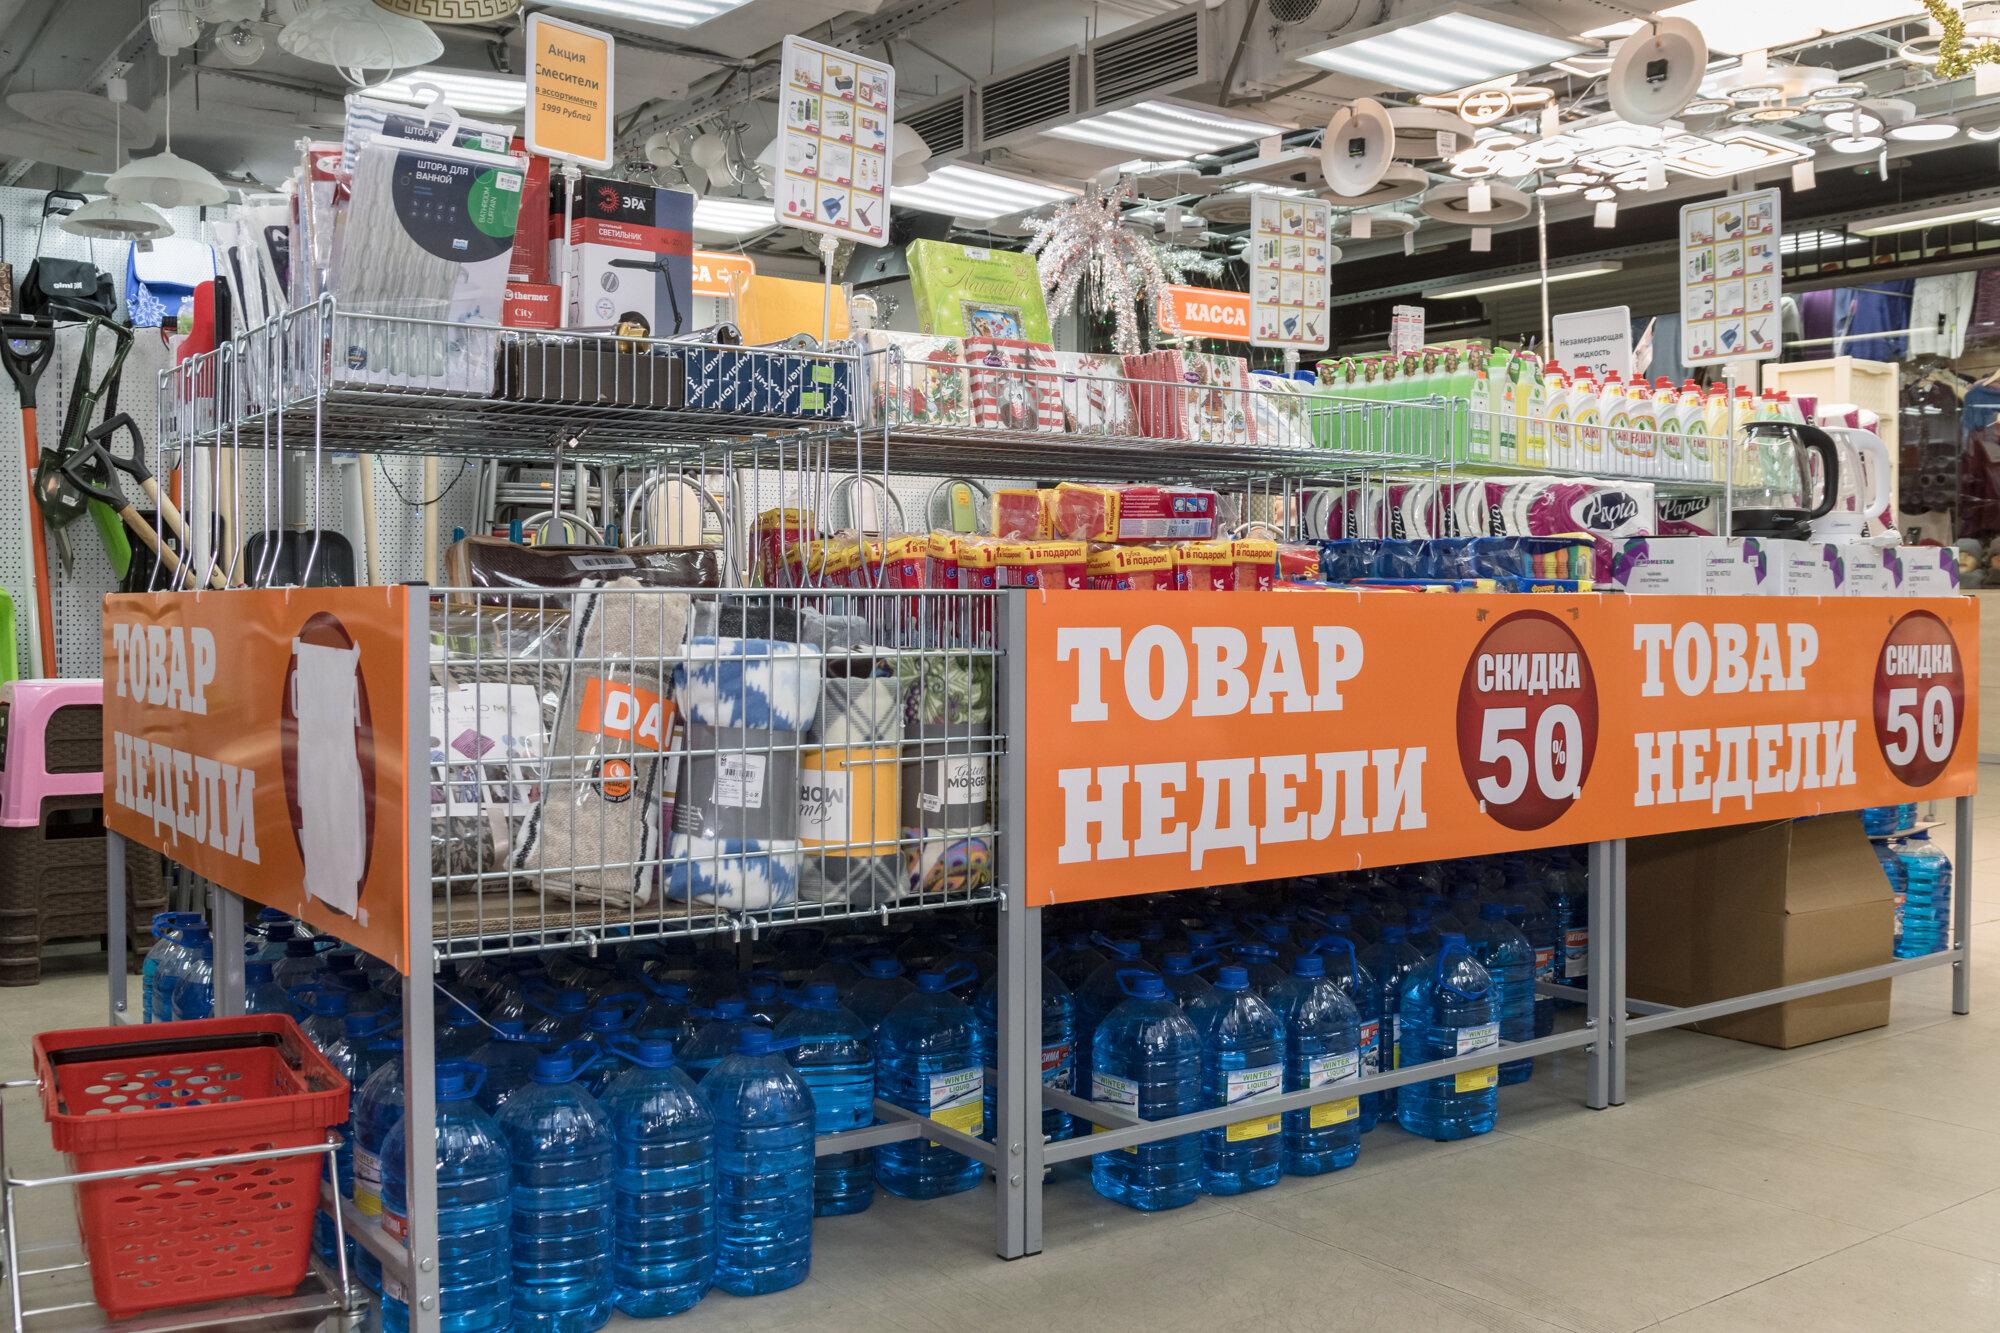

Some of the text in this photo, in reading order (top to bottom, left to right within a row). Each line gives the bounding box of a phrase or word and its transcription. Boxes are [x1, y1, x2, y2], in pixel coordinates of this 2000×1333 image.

[548, 43, 586, 64] Акция
[535, 63, 599, 90] Смесители
[541, 87, 598, 108] ассортименте
[541, 102, 592, 121] 1999 Рублей
[404, 125, 435, 138] ШТОРА
[417, 159, 469, 176] ШТОРА ДЛЯ
[415, 171, 453, 185] ВАННОЙ
[478, 186, 491, 224] BATHROOM
[486, 196, 497, 225] CURTAIN
[622, 196, 646, 211] ЭРА
[598, 228, 642, 241] СВЕТИЛЬНИК
[514, 290, 549, 302] thermex
[514, 307, 534, 318] City
[1185, 302, 1247, 327] КАССА
[1559, 332, 1625, 347] Незамерзающая
[1573, 349, 1612, 360] жидкость
[1631, 432, 1653, 445] FAIRY
[1587, 490, 1638, 532] Papia
[1662, 496, 1711, 521] Papia
[1036, 550, 1042, 558] в
[1043, 547, 1082, 560] подарок!
[1126, 553, 1168, 566] в подарок!
[1192, 549, 1227, 561] подарок!
[1241, 549, 1273, 560] подарок!
[1633, 622, 1820, 698] ТОВАР
[1885, 643, 1954, 680] СКИДКА
[113, 622, 217, 715] ТОВАР
[1056, 624, 1365, 723] ТОВАР
[1476, 651, 1582, 696] СКИДКА
[463, 704, 517, 715] HOME
[1633, 719, 1858, 815] НЕДЕЛИ
[113, 732, 261, 865] НЕДЕЛИ
[1057, 746, 1428, 872] НЕДЕЛИ
[1467, 1027, 1492, 1039] WINTER
[1321, 1057, 1350, 1071] WINTER
[943, 1071, 975, 1085] WINTER
[1242, 1070, 1273, 1082] WINTER
[1326, 1067, 1346, 1078] LIQUID
[949, 1083, 970, 1093] LIQUID
[1099, 1075, 1126, 1091] WINTER
[1246, 1080, 1268, 1090] LIQUID
[1103, 1087, 1122, 1099] LIQUID
